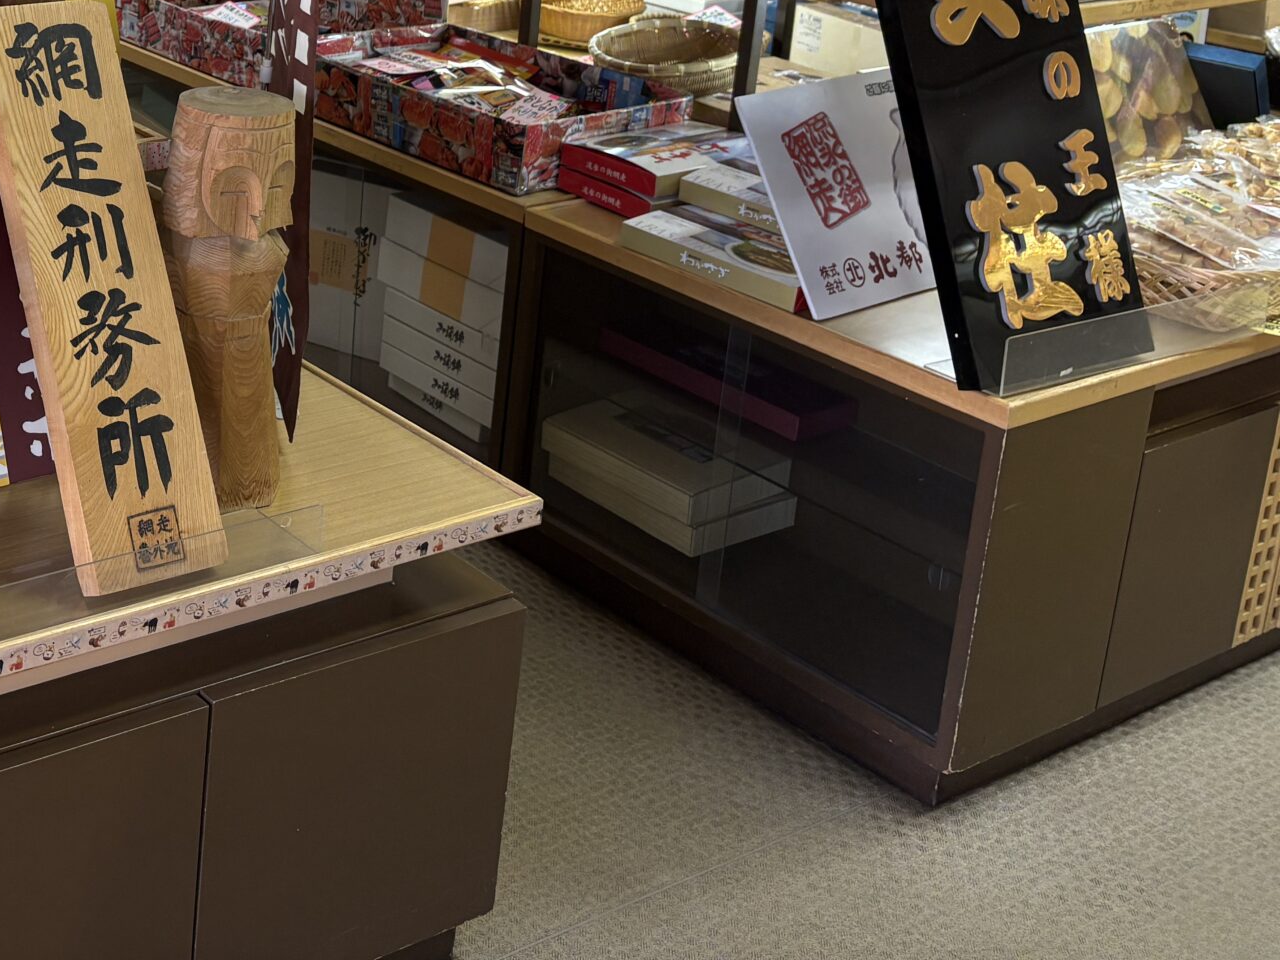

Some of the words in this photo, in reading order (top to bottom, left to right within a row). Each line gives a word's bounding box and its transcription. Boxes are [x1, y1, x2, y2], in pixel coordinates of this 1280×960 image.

[3, 22, 175, 500] 網走刑務所
[819, 262, 841, 280] 株式
[868, 239, 923, 284] 北都
[824, 279, 846, 296] 会社
[136, 513, 175, 538] 網走
